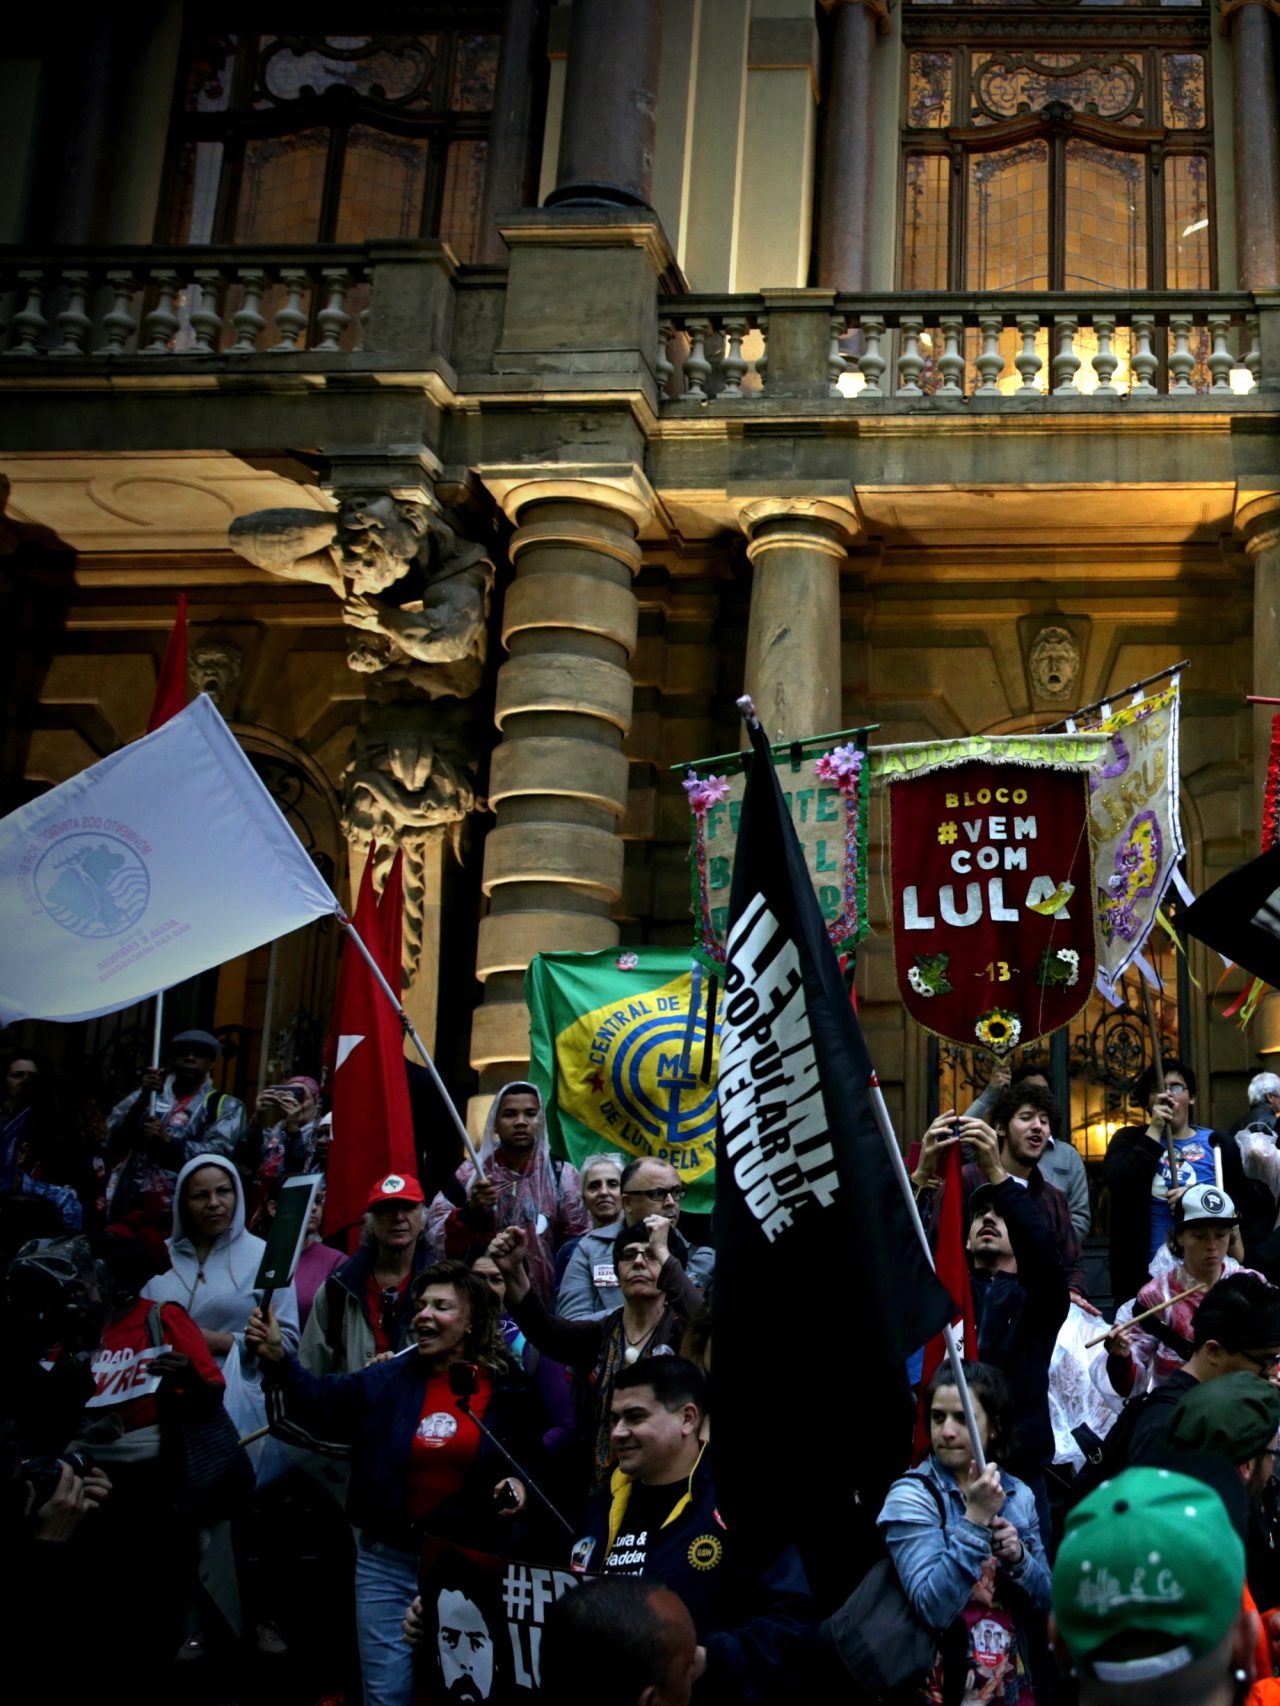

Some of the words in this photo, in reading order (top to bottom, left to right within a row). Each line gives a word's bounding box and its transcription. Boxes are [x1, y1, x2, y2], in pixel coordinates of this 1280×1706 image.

[882, 736, 992, 773] ADDAD
[945, 787, 1029, 809] BLOCO
[937, 815, 1038, 846] #VEM
[950, 845, 1028, 874] COM
[902, 875, 1071, 931] LULA
[589, 999, 653, 1065] CENTRAL
[656, 995, 681, 1012] DE
[723, 958, 793, 1162] POPULAR
[600, 1100, 622, 1126] DE
